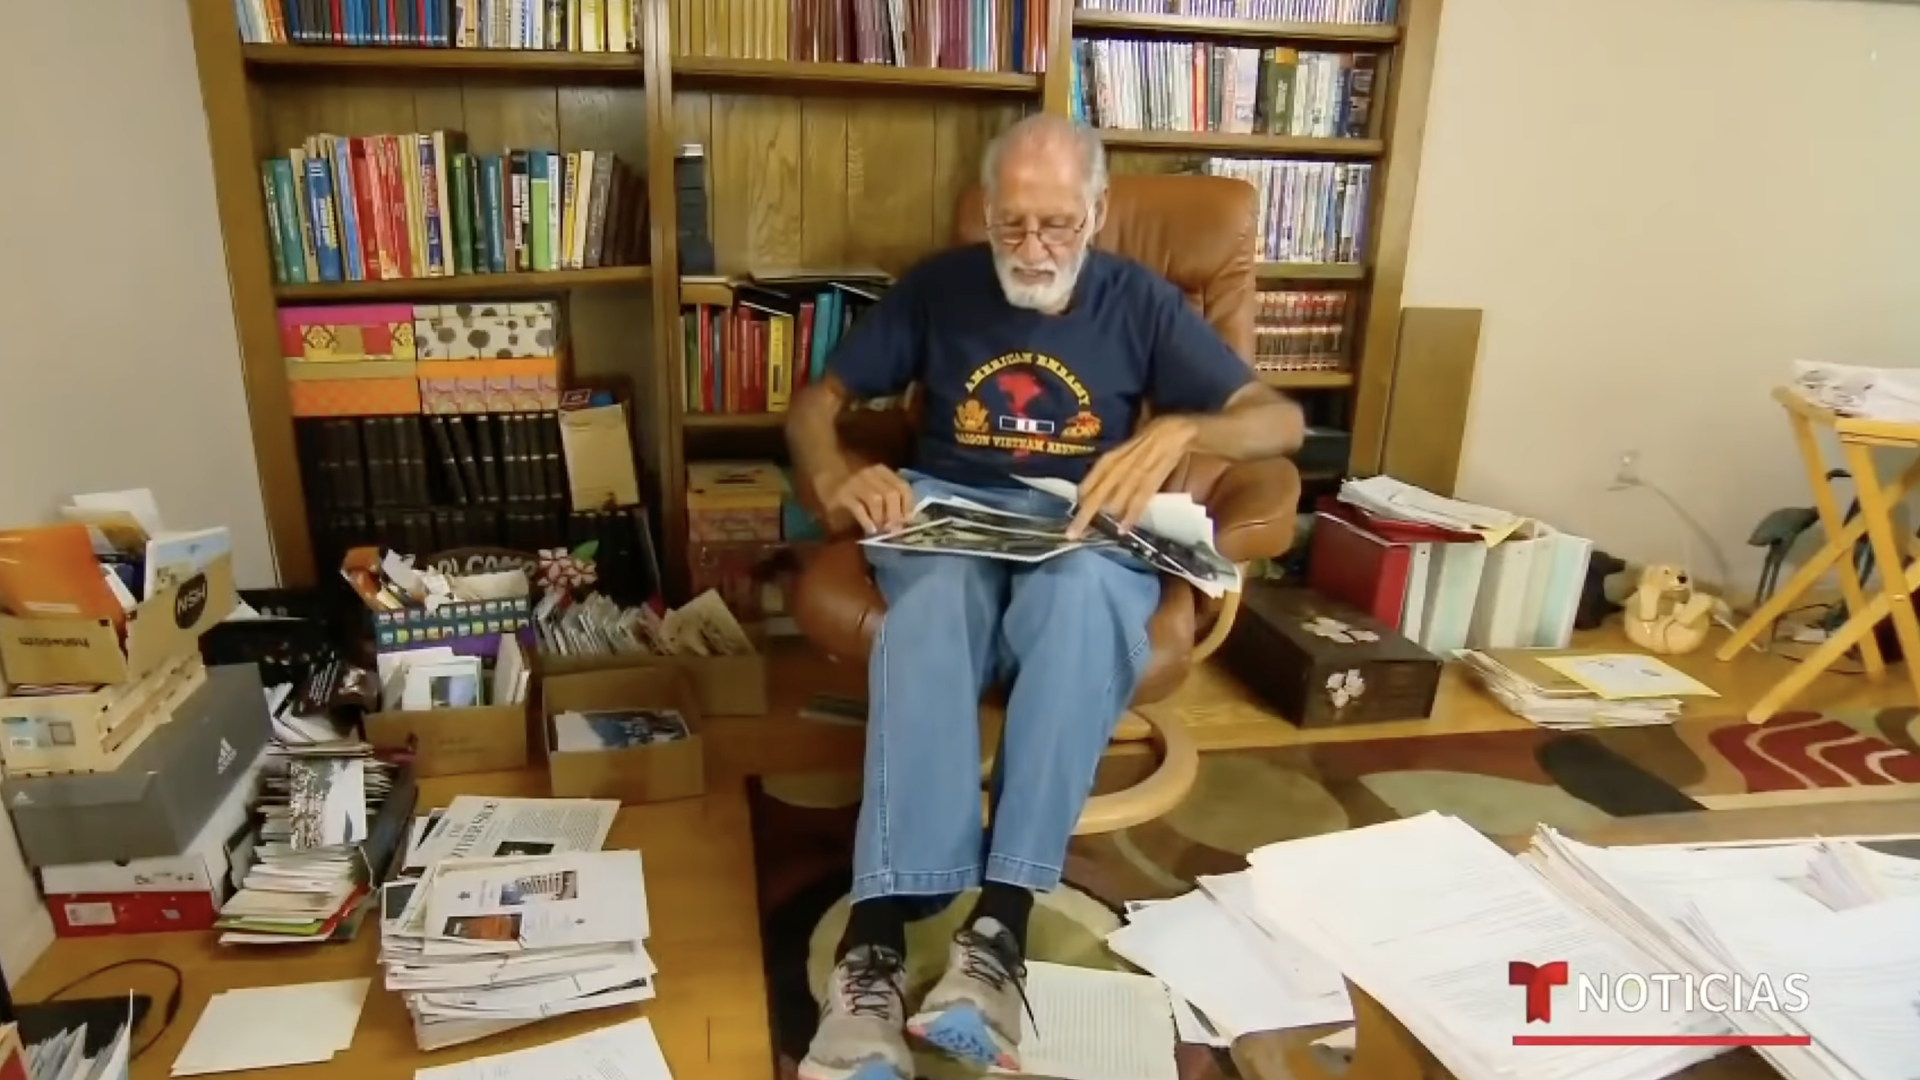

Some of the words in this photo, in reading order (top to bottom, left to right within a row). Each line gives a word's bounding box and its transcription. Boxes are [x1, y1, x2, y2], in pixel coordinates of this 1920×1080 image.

[965, 352, 1032, 393] AMERICAN
[1036, 354, 1090, 406] EMBASSY
[992, 435, 1047, 452] VIETNAM
